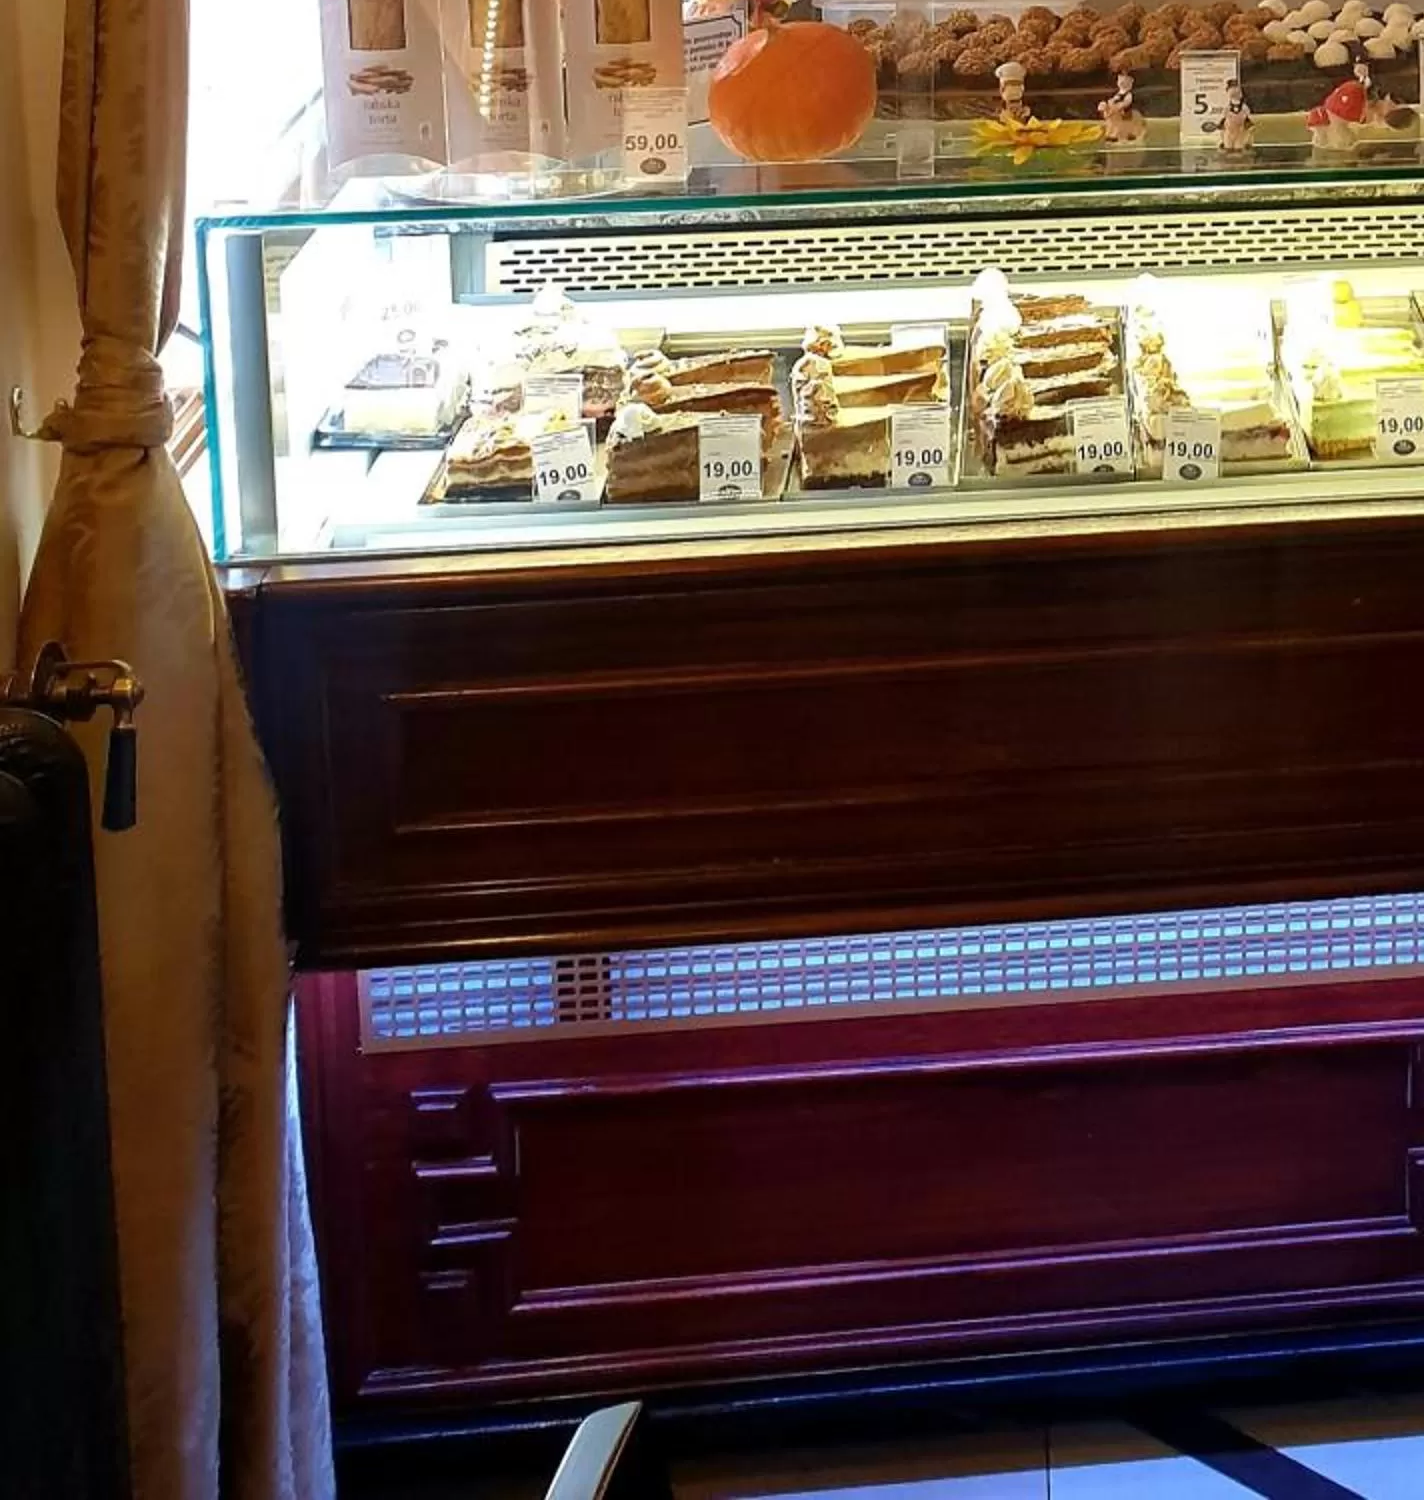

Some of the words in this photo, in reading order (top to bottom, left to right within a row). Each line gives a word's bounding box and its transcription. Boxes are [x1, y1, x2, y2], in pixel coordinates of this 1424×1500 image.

[625, 133, 677, 152] 59,00
[1378, 416, 1423, 435] 19,00
[895, 449, 943, 469] 19,00
[1077, 442, 1123, 461] 19,00
[1167, 440, 1213, 459] 19,00
[539, 463, 588, 487] 19,00
[703, 460, 752, 480] 19,00
